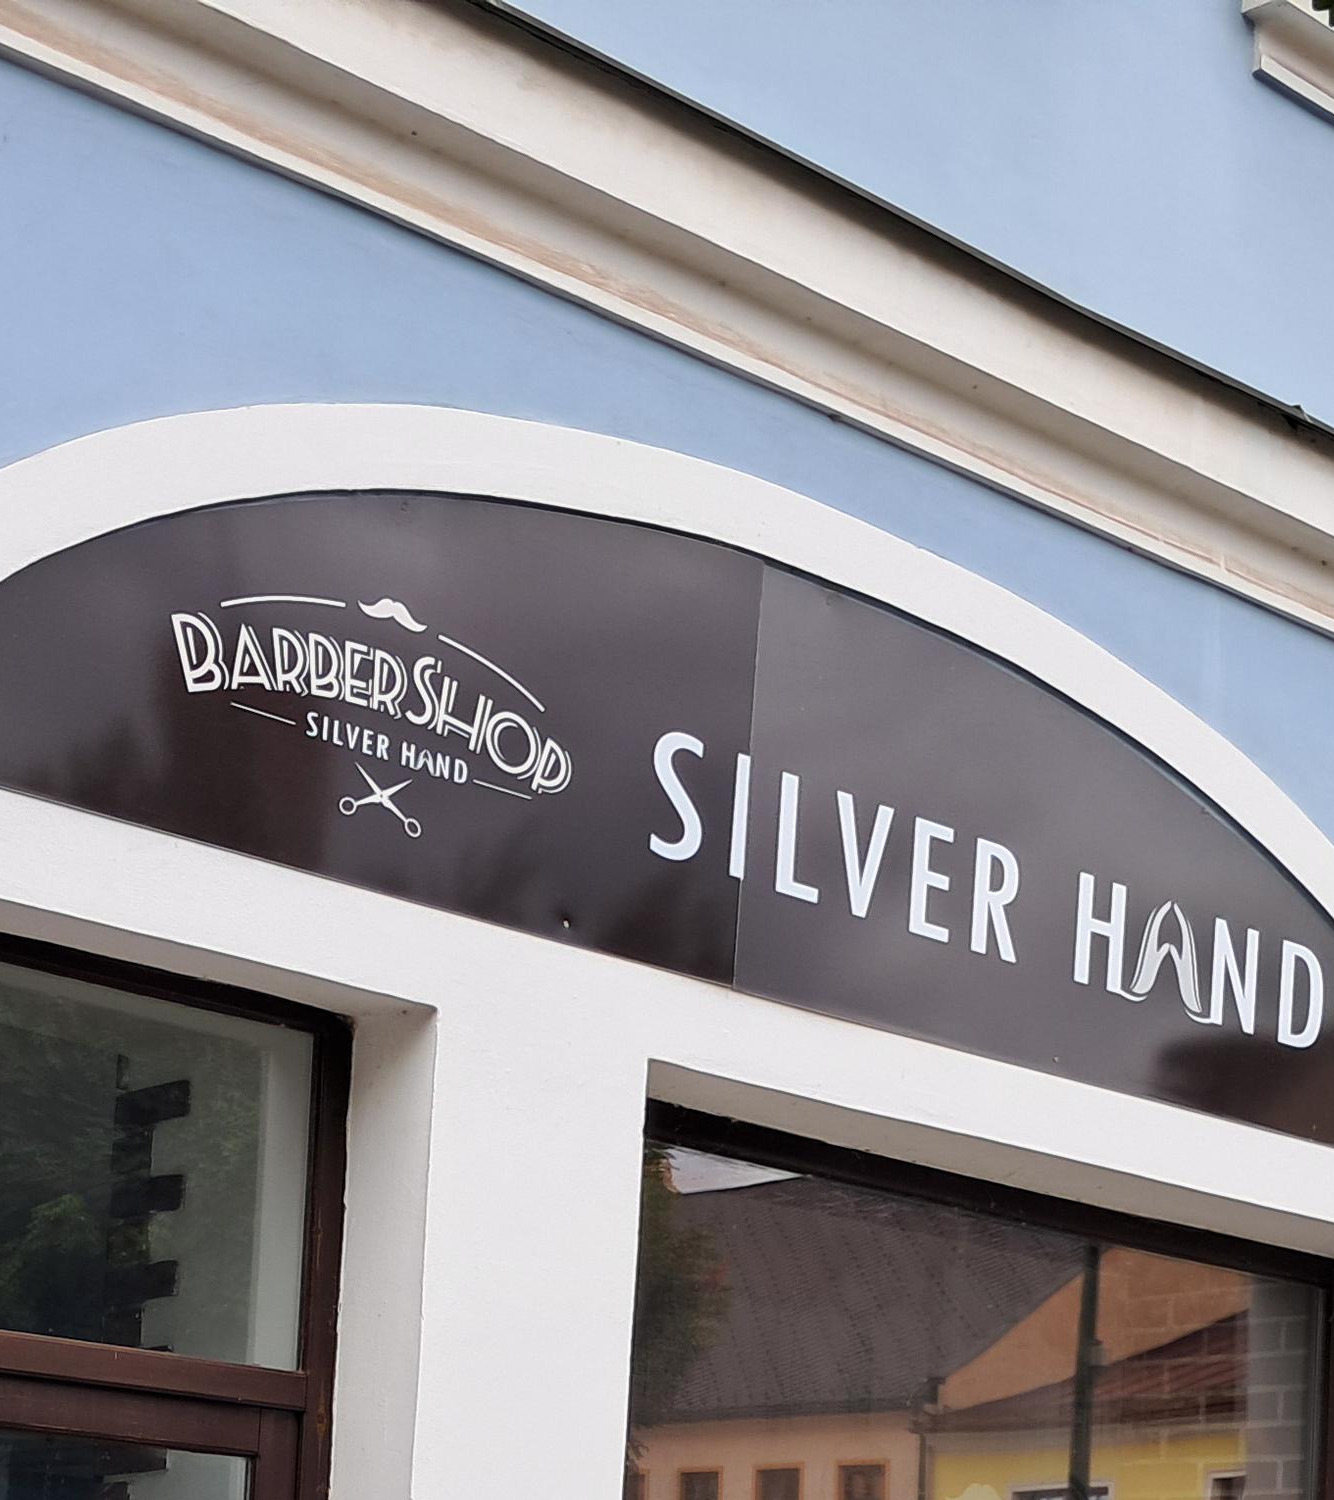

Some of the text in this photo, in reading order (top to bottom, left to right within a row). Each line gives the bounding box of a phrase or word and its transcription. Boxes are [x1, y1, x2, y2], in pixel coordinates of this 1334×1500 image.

[305, 711, 468, 785] SILVER HAND
[649, 731, 1325, 1050] SILVER HAND
